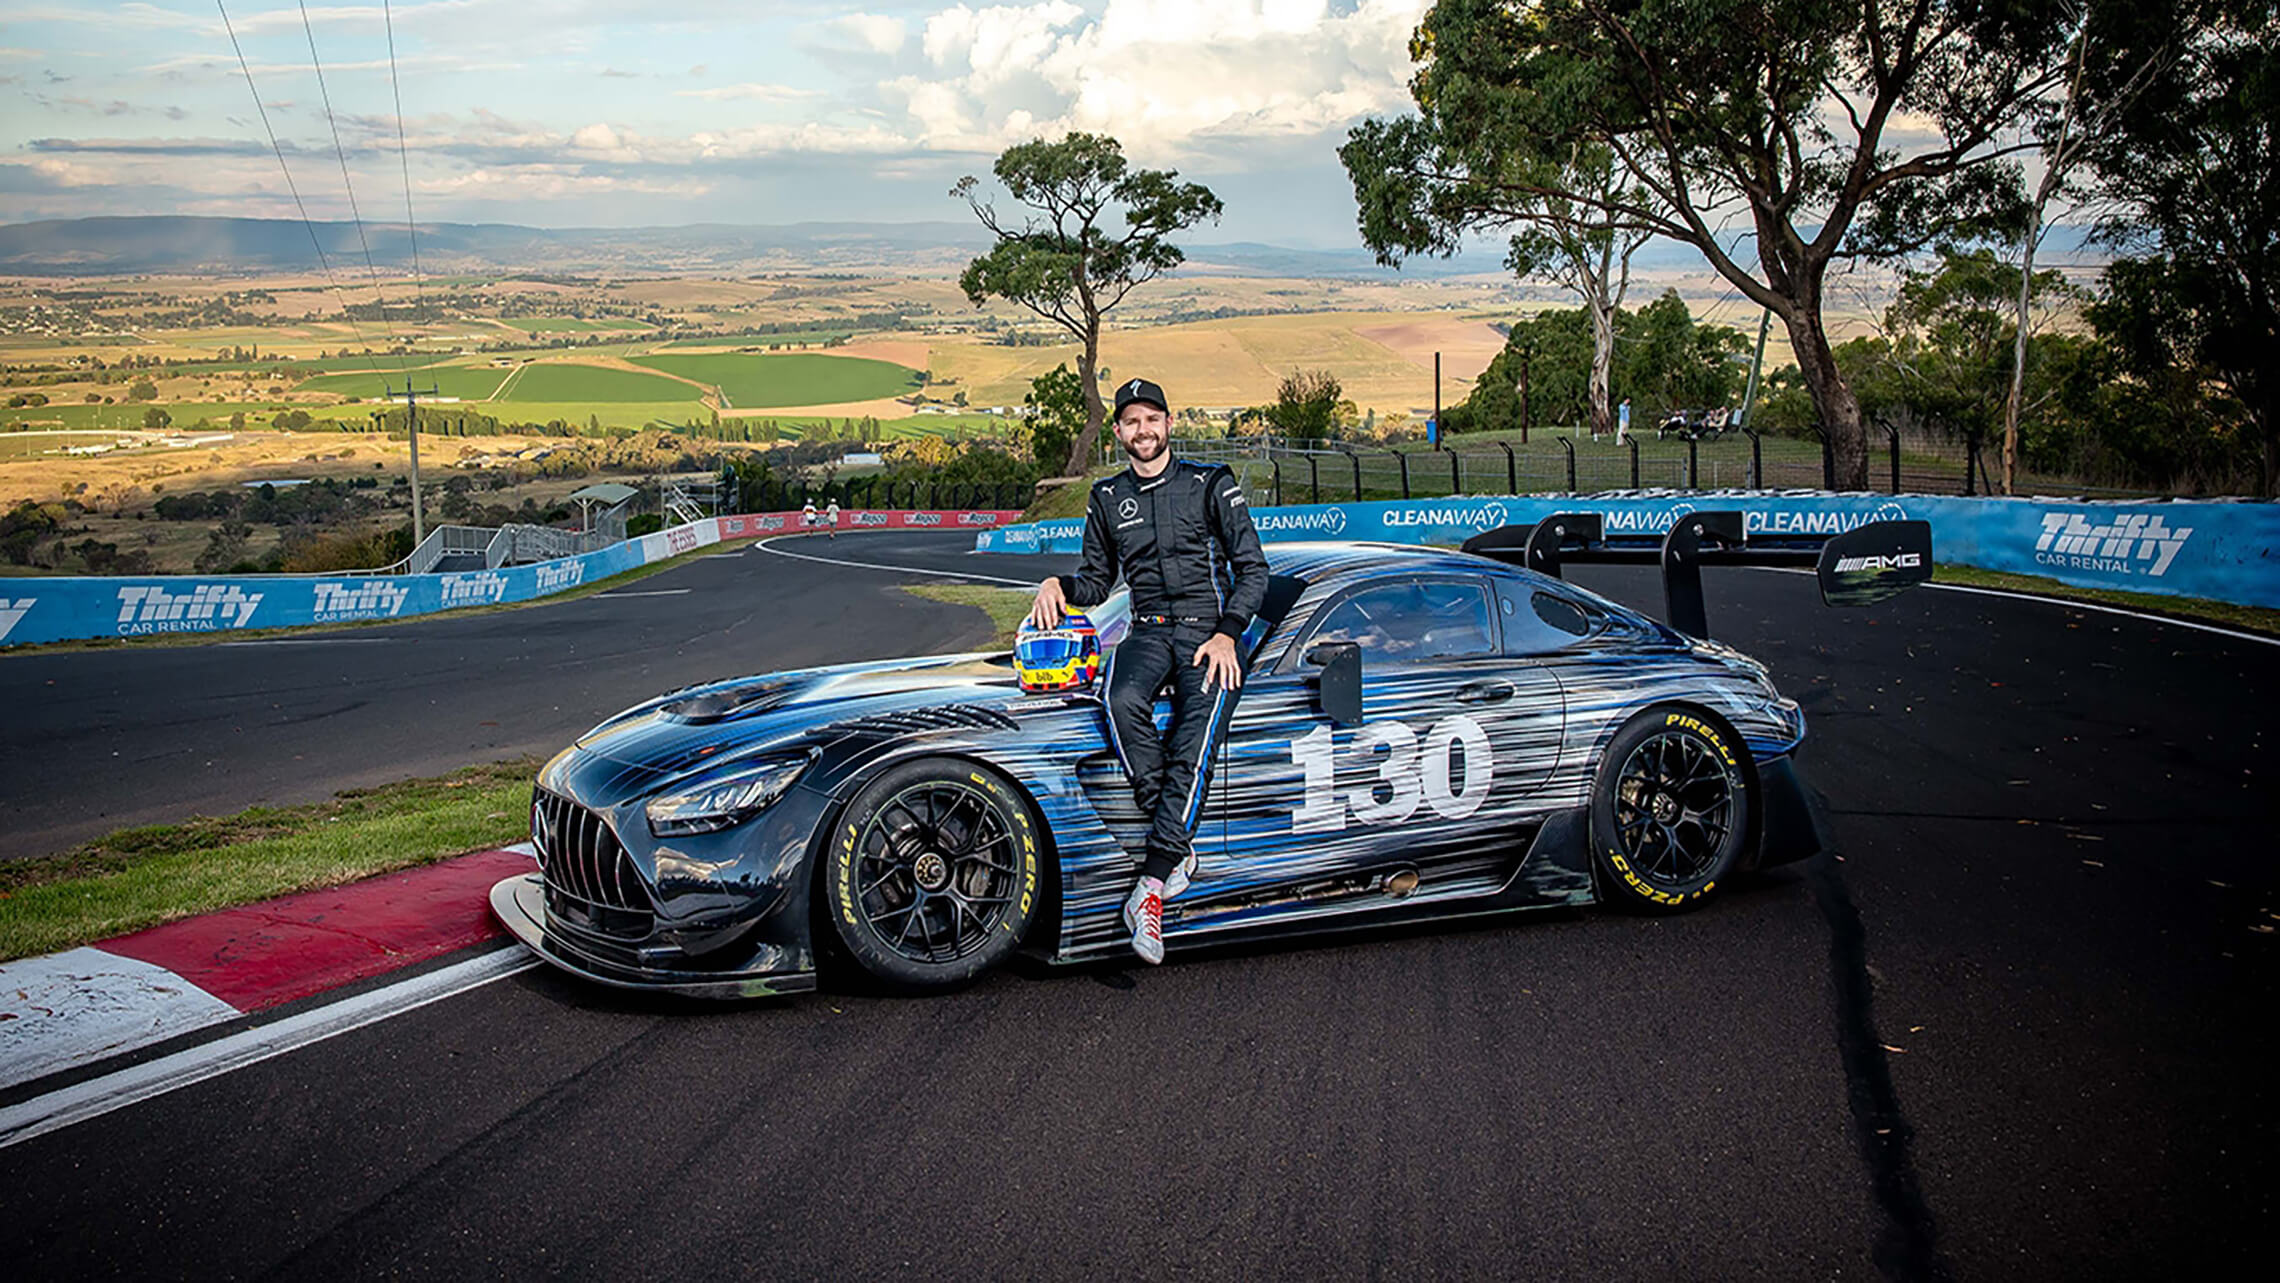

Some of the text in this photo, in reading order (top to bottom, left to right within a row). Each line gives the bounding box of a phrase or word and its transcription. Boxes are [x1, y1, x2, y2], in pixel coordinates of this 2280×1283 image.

[1252, 510, 1342, 531] LEANAWAY
[1383, 506, 1502, 527] CLEANAWAY
[1040, 526, 1083, 538] CLEANA
[2035, 513, 2194, 576] Thrifty
[536, 560, 586, 589] Thrifty
[1861, 552, 1921, 570] AMG
[2035, 552, 2132, 574] CAR RENTAL
[313, 581, 410, 616] Thrifty
[440, 572, 509, 602] Thrifty
[117, 585, 264, 628] Thrifty
[314, 609, 379, 622] CAR RENTAL
[117, 620, 217, 635] CAR RENTAL
[1665, 714, 1737, 766] PIRELLI
[1291, 715, 1494, 835] 130
[838, 823, 858, 925] PIRELLI
